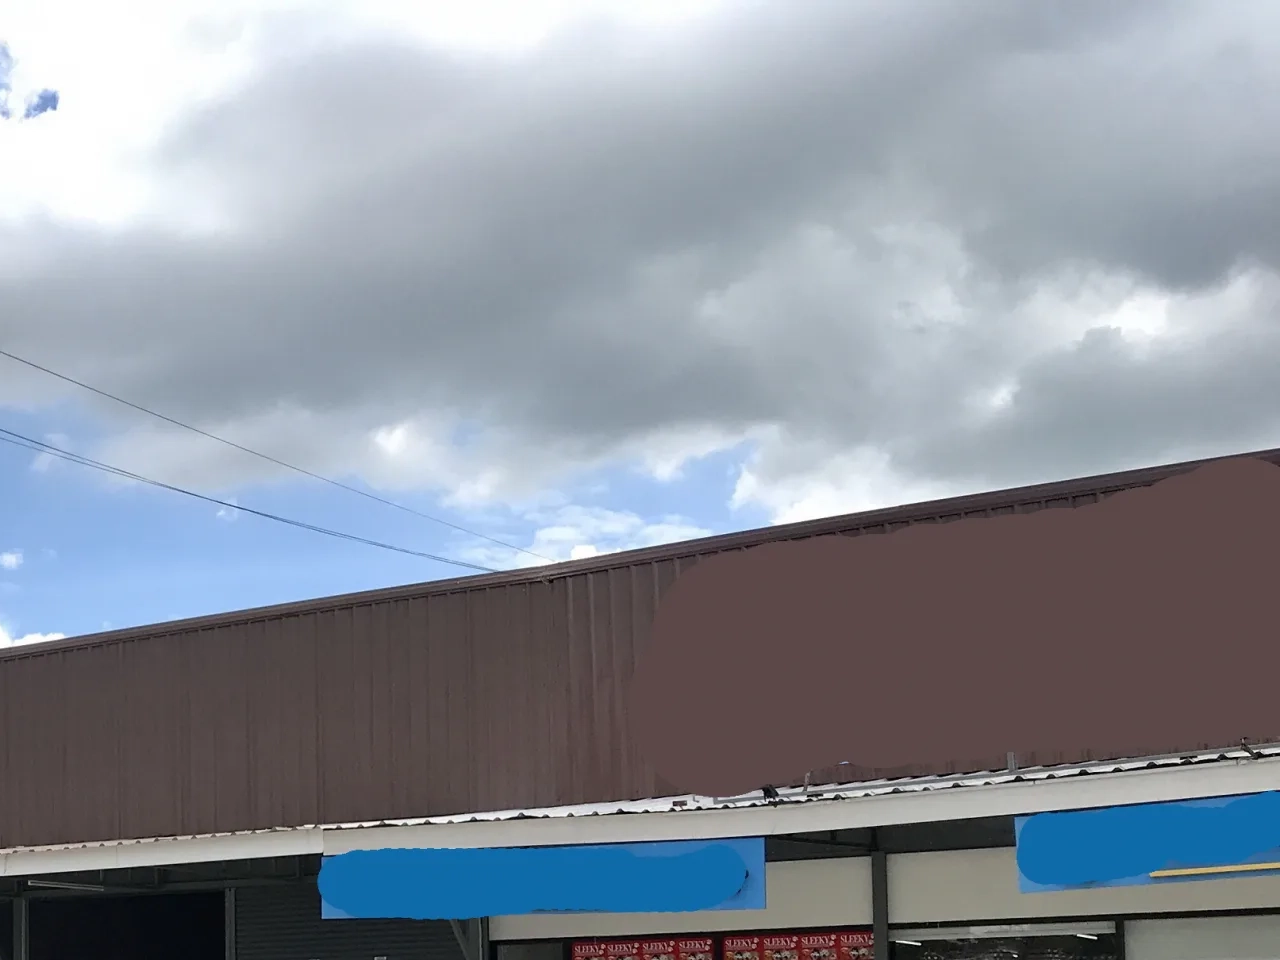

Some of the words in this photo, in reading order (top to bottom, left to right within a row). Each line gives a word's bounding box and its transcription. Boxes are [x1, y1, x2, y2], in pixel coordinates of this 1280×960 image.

[725, 938, 753, 947] SLEEKY
[763, 937, 792, 947] SLEEKY
[801, 935, 831, 945] SLEEKY
[840, 934, 870, 944] SLEEKY
[574, 945, 600, 953] SLEEKY
[607, 943, 633, 952] SLEEKY
[642, 942, 669, 951] SLEEKY
[679, 940, 706, 950] SLEEKY
